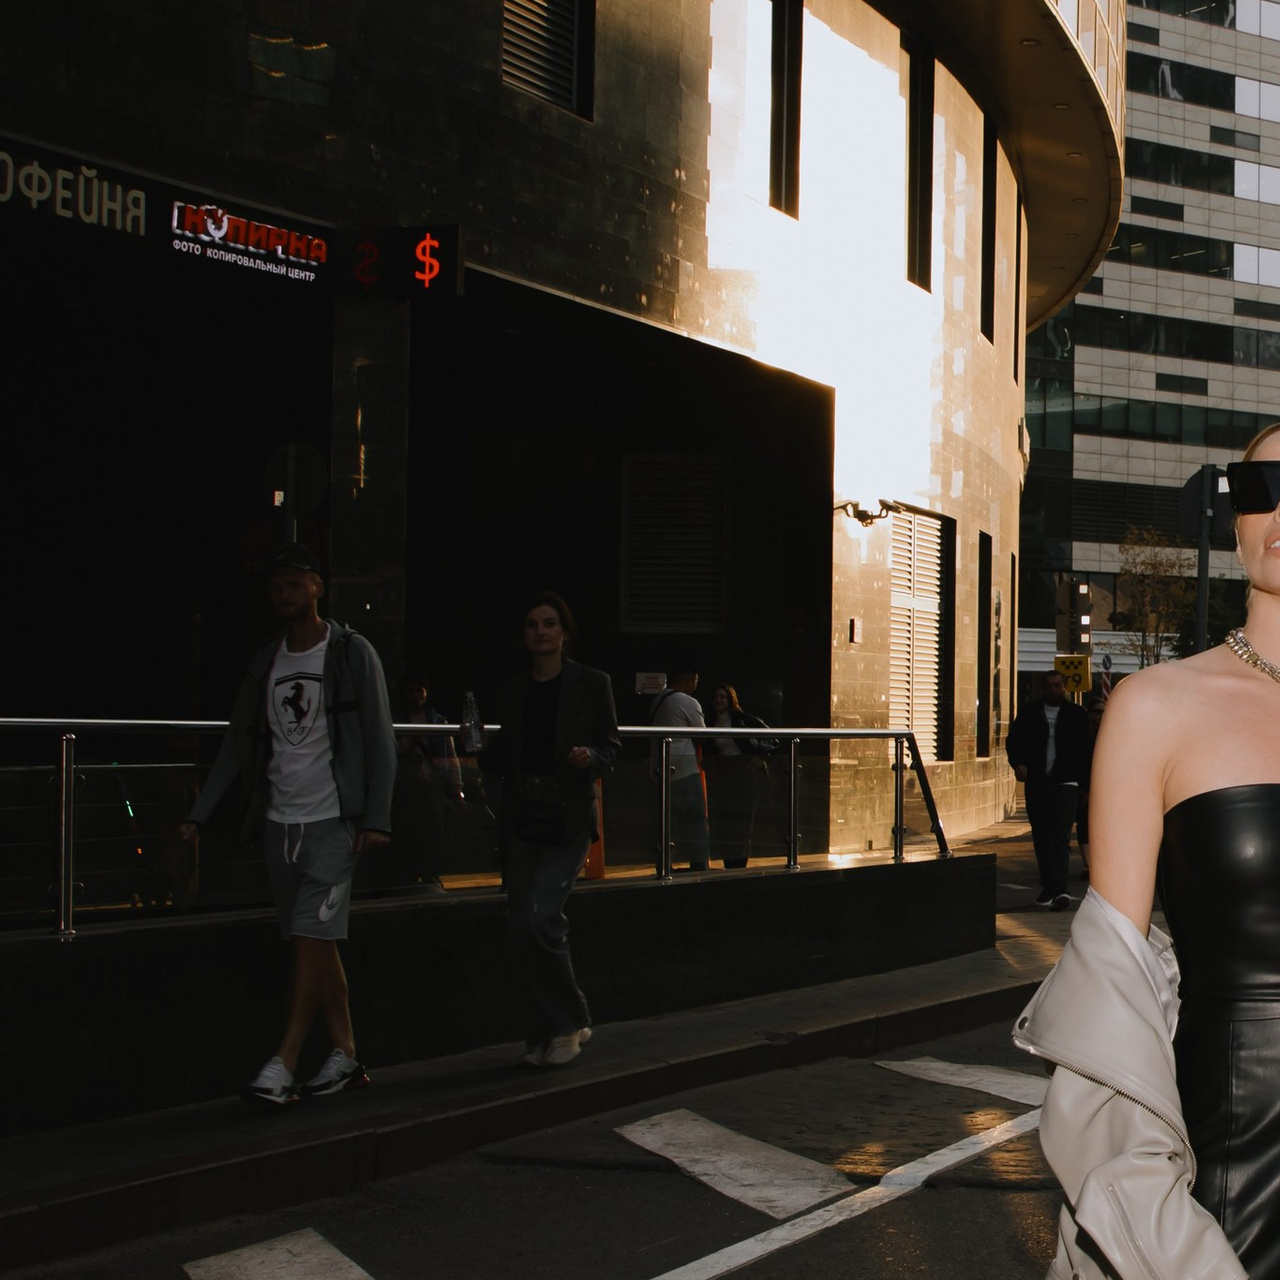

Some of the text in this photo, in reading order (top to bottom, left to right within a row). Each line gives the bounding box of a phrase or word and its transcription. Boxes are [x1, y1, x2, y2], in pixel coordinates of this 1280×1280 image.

[172, 239, 316, 282] ФОТО КОПИРОВАЛЬНЫЙ ЦЕНТР
[414, 232, 440, 289] $
